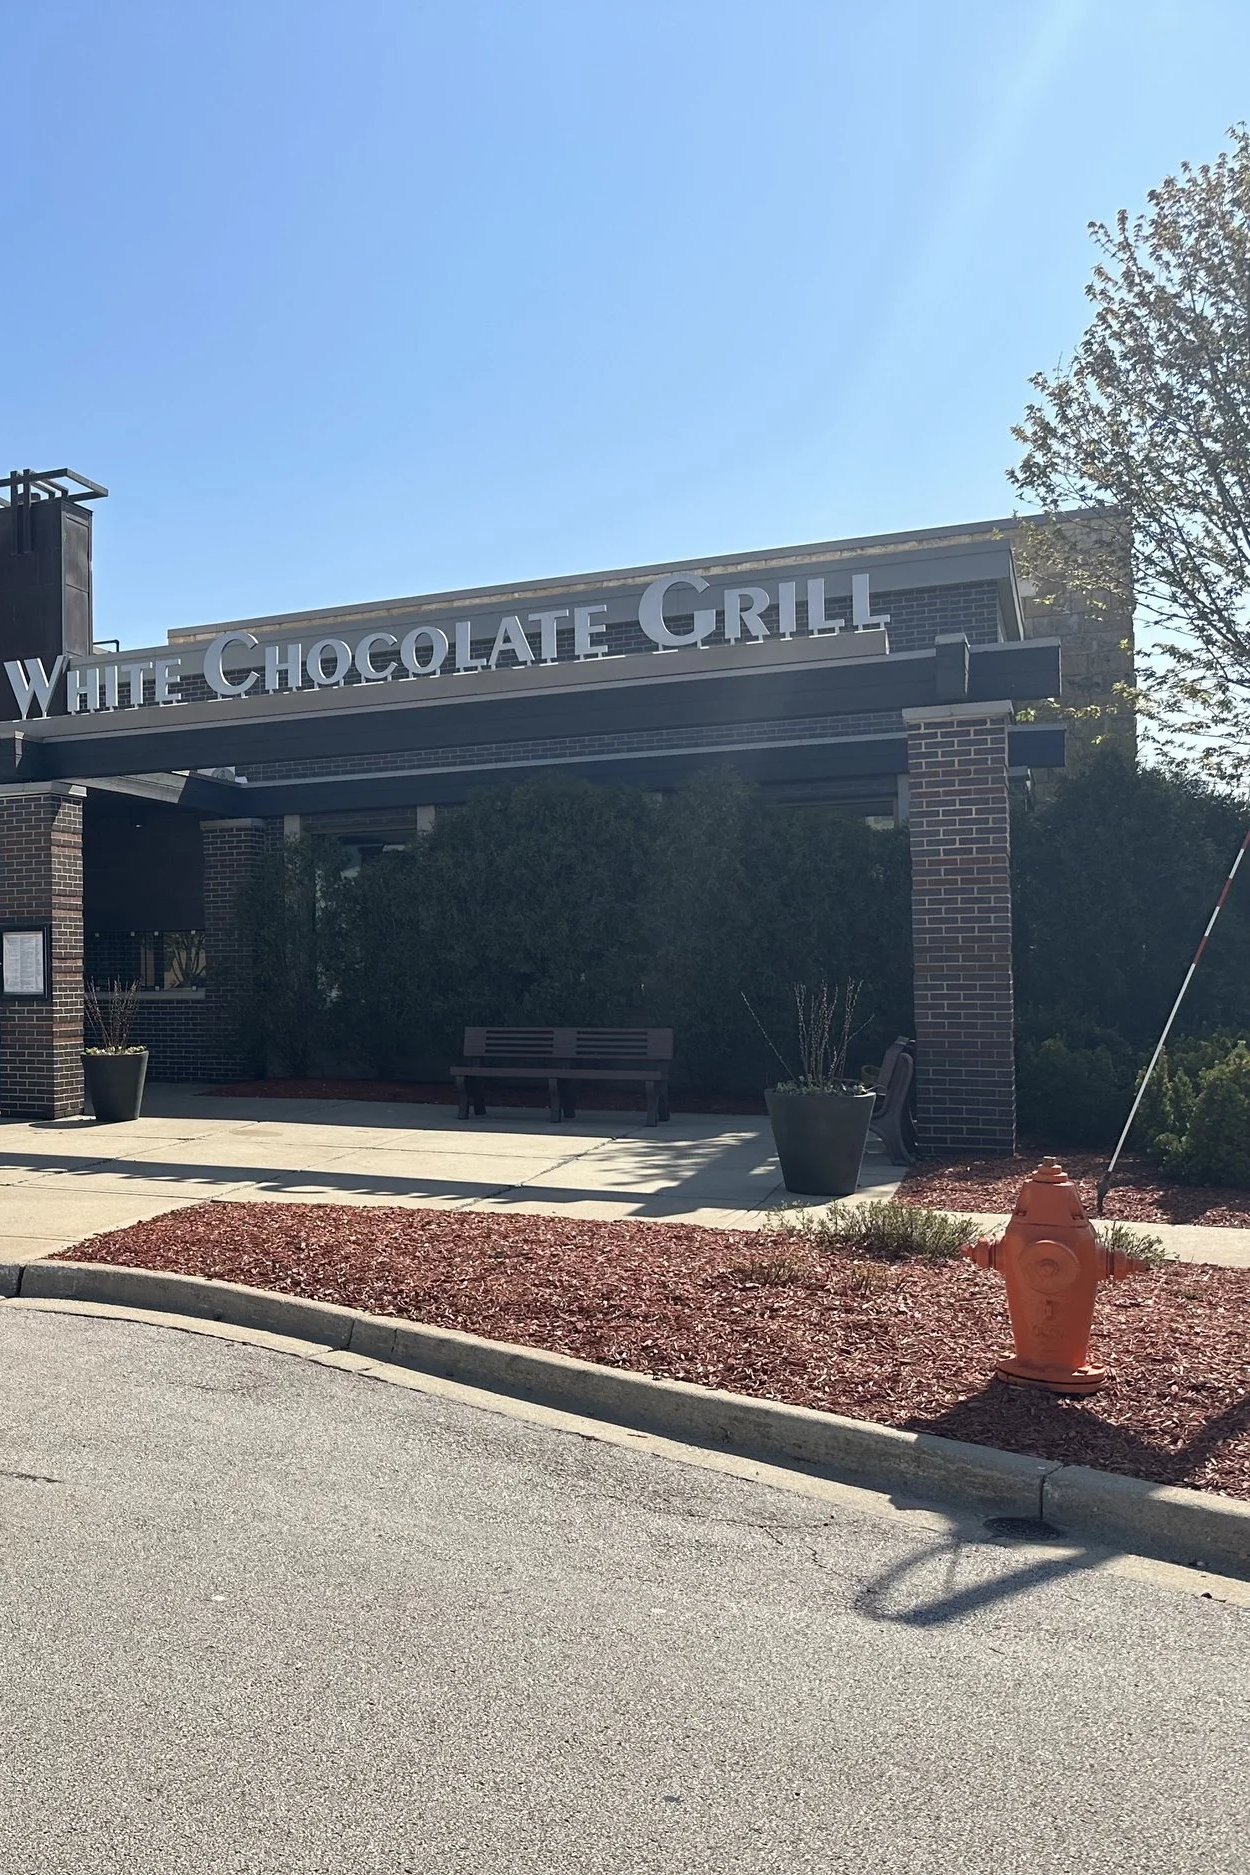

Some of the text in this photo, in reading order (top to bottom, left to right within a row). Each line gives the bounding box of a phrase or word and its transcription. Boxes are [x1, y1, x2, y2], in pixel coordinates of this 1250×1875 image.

[3, 655, 182, 716] WHITE
[203, 604, 608, 696] CHOCOLATE
[638, 572, 891, 647] GRILL
